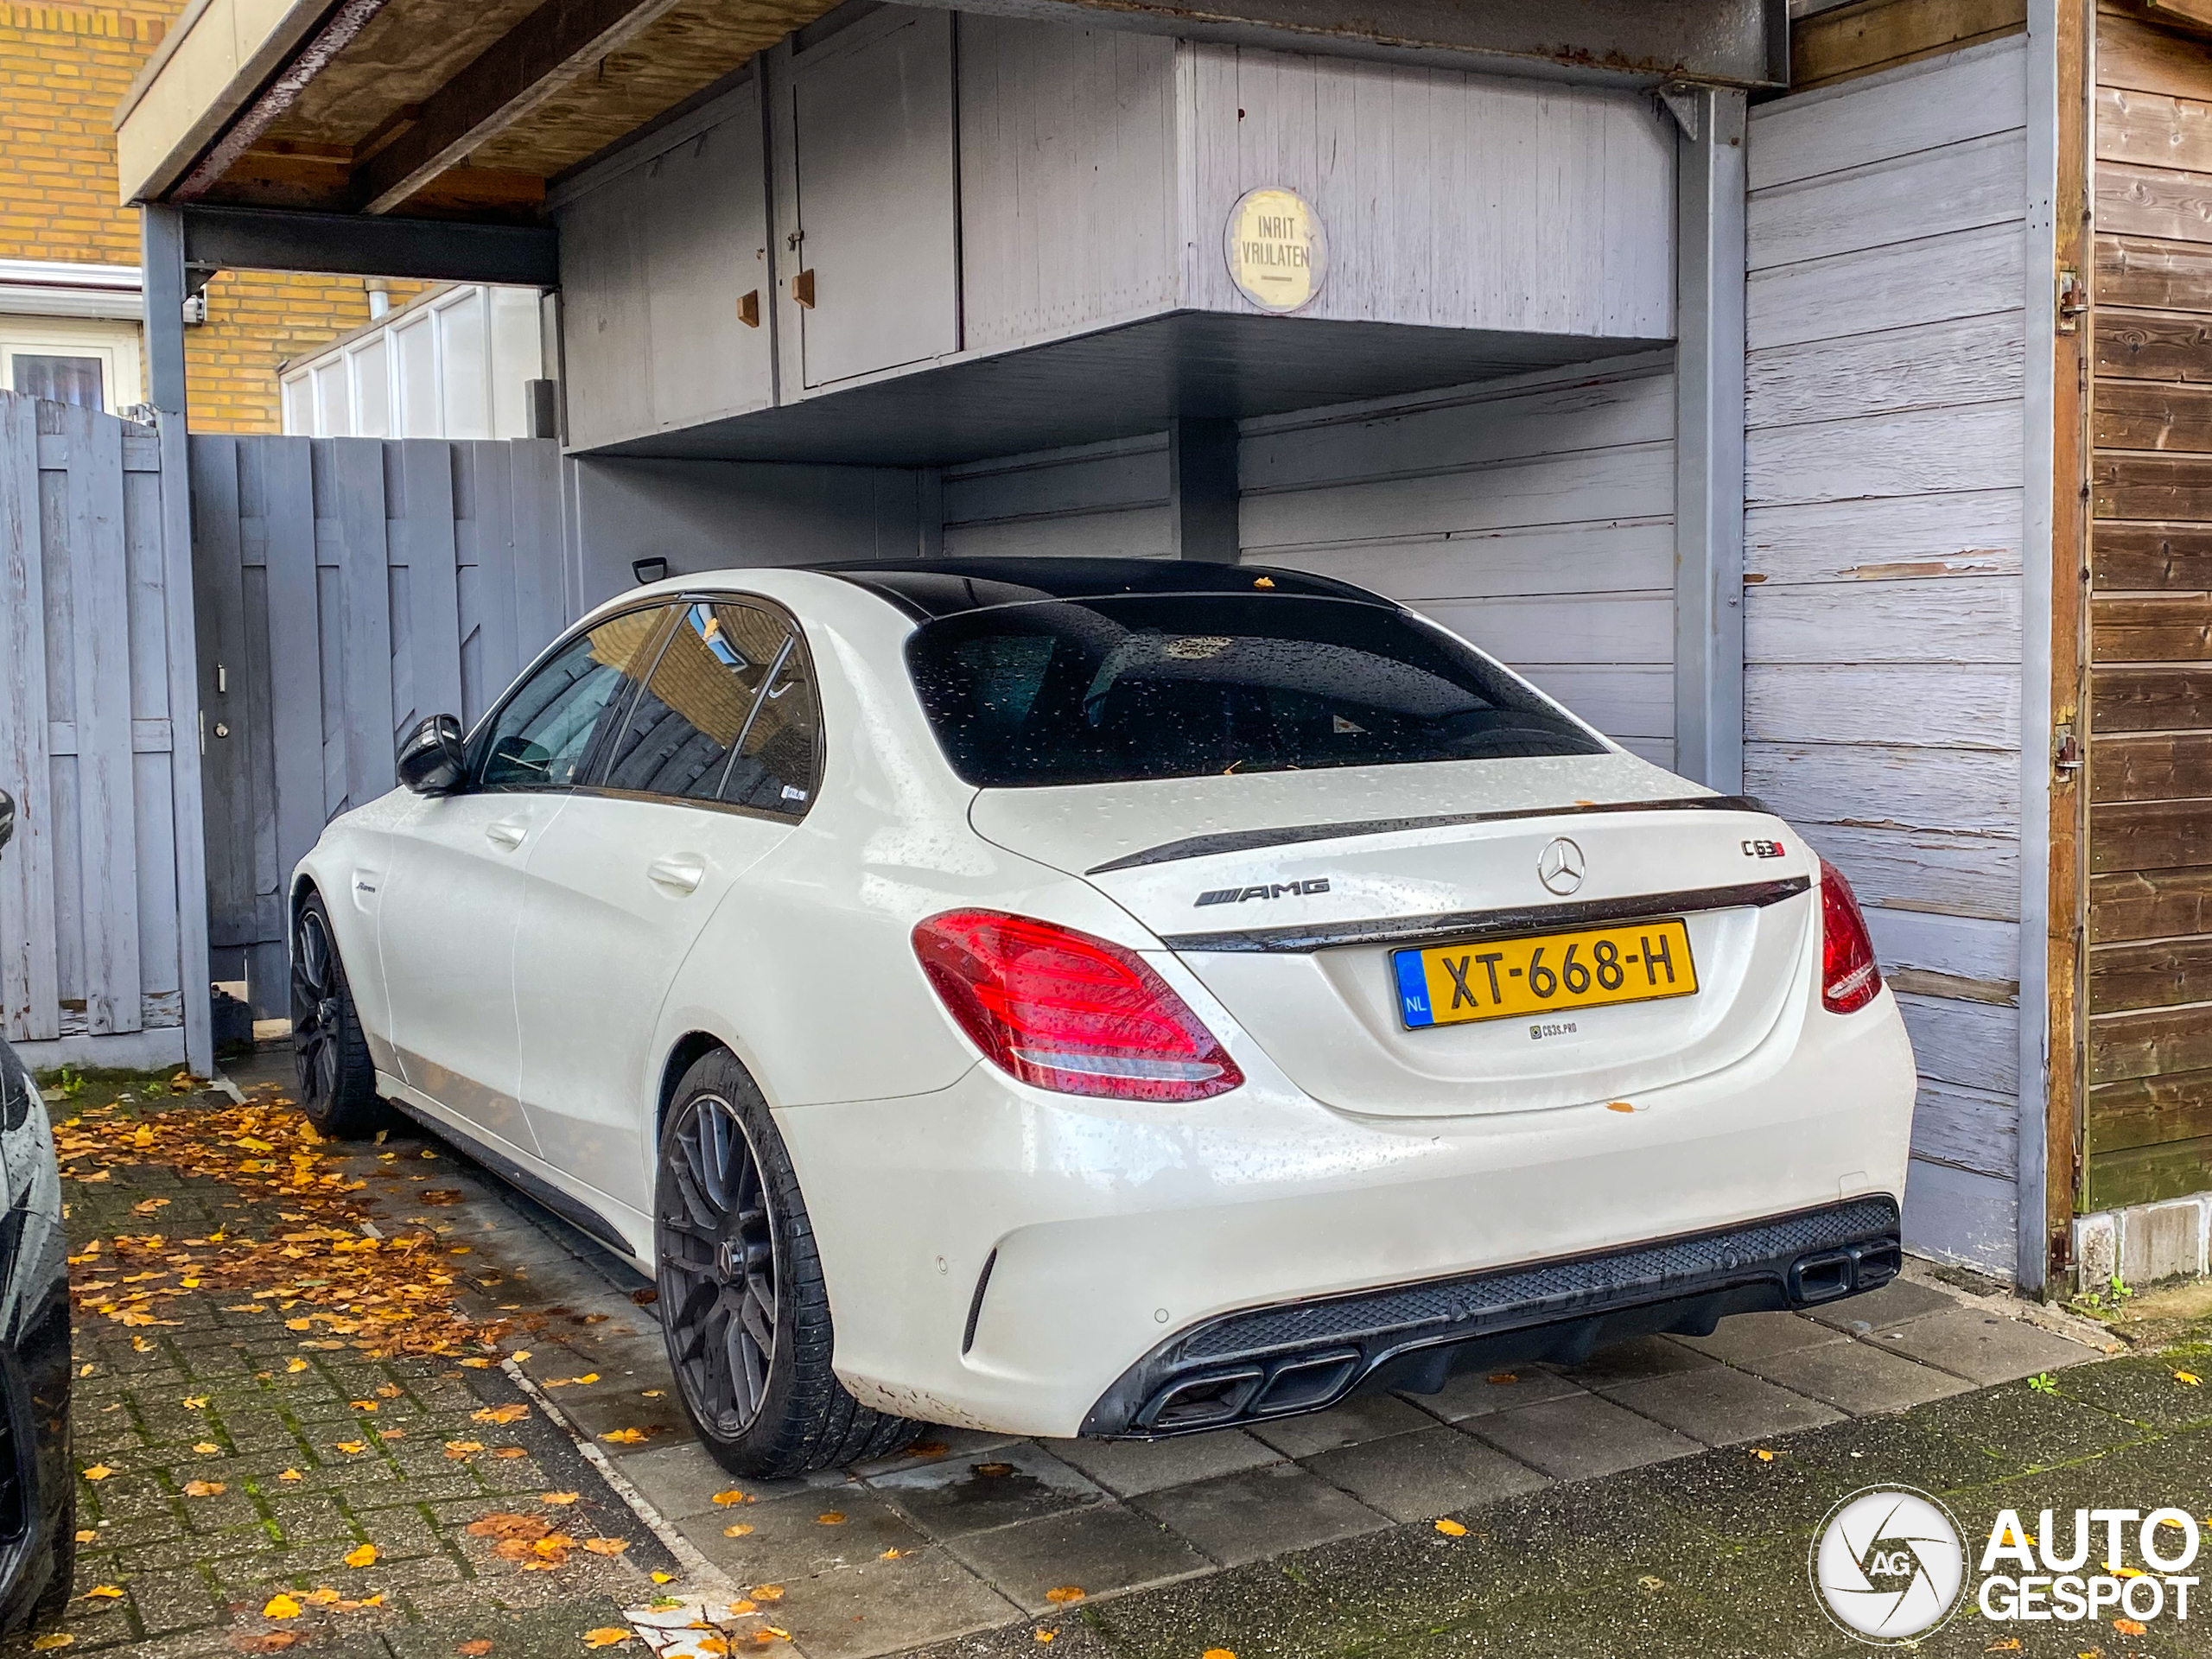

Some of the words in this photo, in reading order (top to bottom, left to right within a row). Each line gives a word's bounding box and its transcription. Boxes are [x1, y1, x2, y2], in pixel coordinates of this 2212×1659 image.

[1258, 215, 1294, 239] INRIT
[1243, 241, 1310, 268] VRIJLATEN
[1237, 878, 1331, 902] AMG
[1441, 934, 1675, 1009] XT-668-H
[1406, 995, 1427, 1013] NL
